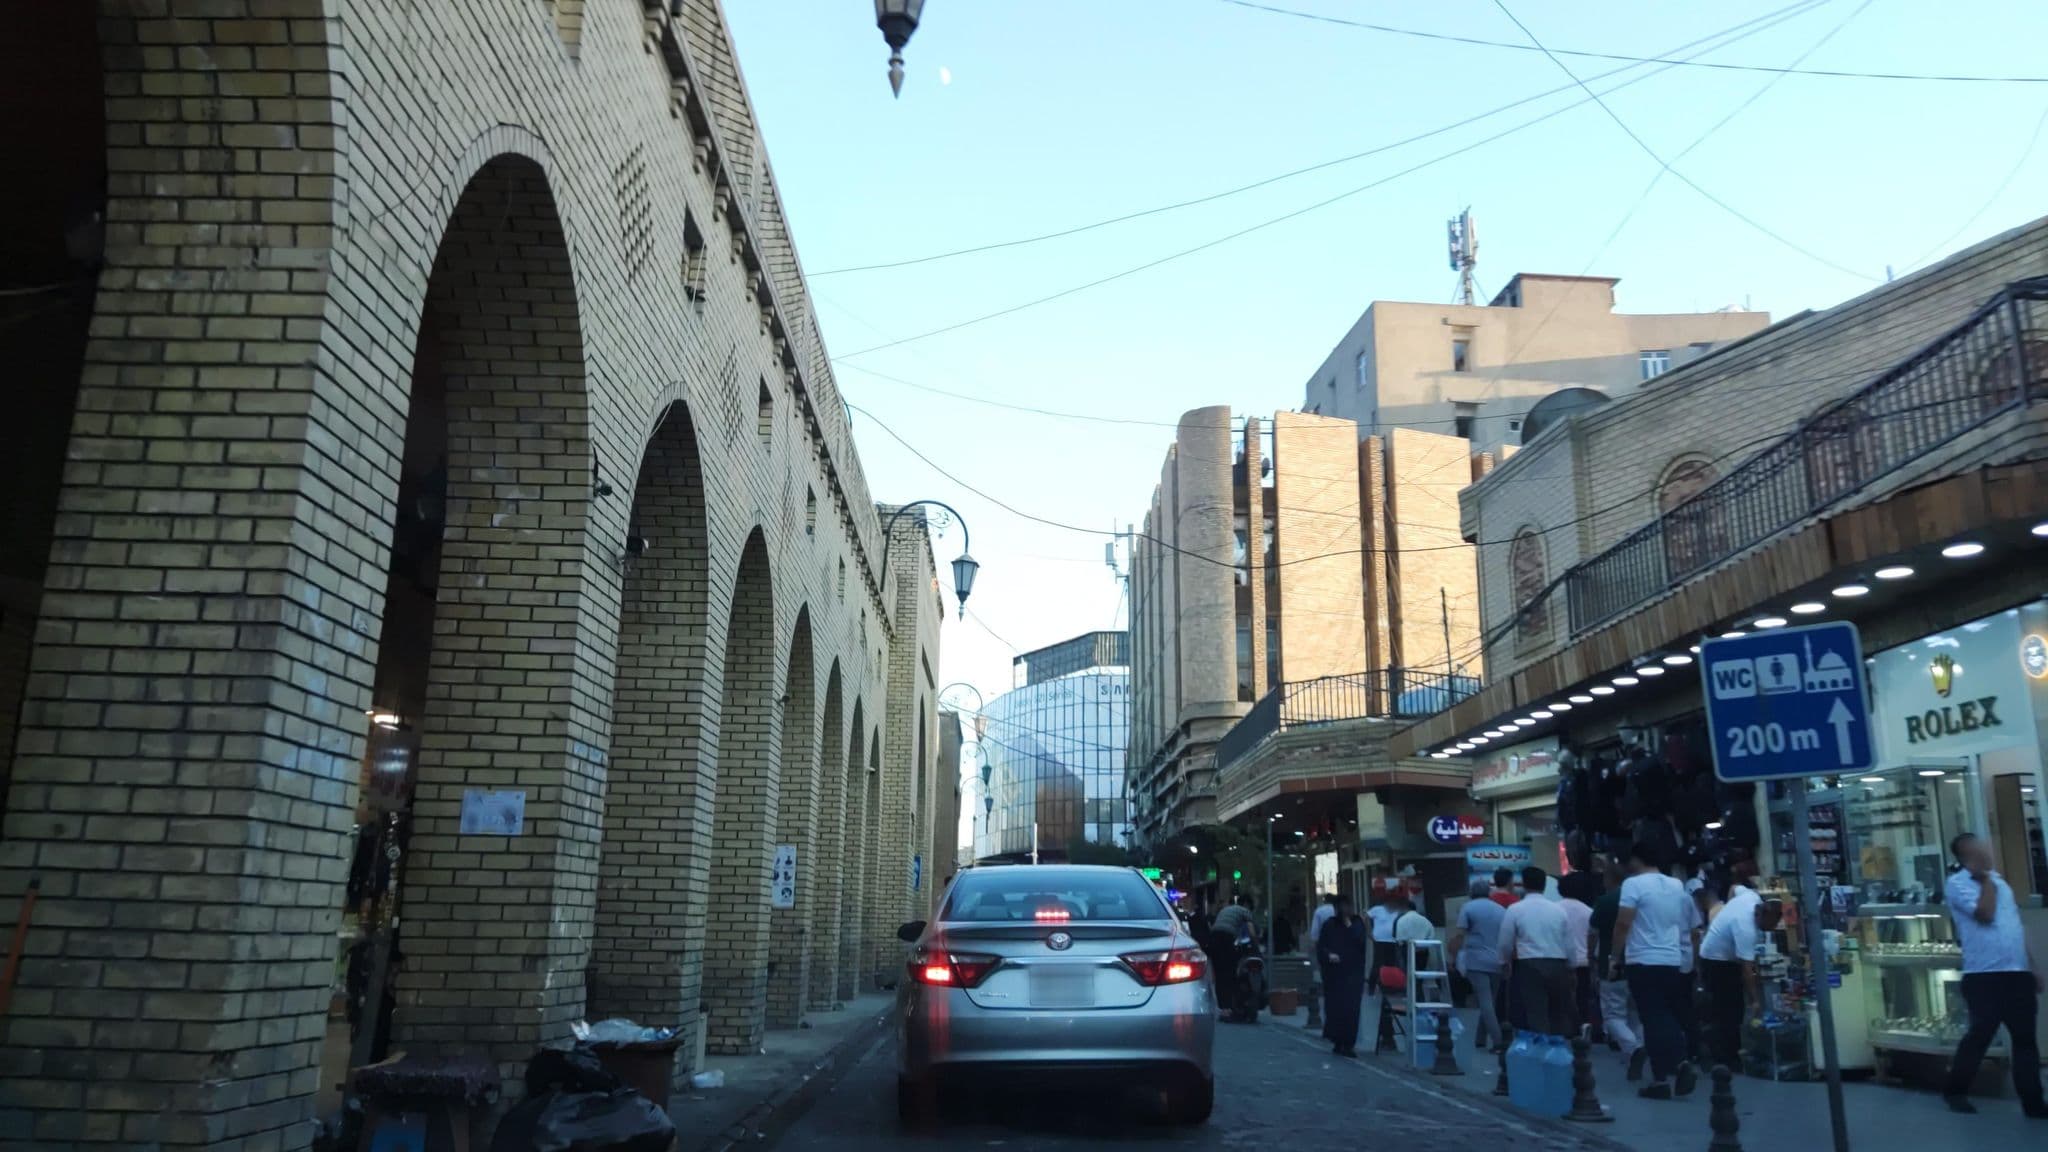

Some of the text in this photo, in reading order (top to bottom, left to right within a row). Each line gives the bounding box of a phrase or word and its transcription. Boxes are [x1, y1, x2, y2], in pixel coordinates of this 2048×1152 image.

[1716, 667, 1752, 691] WC
[1904, 695, 2003, 744] ROLEX
[1726, 722, 1821, 758] 200 m
[1436, 819, 1484, 839] صيدلية
